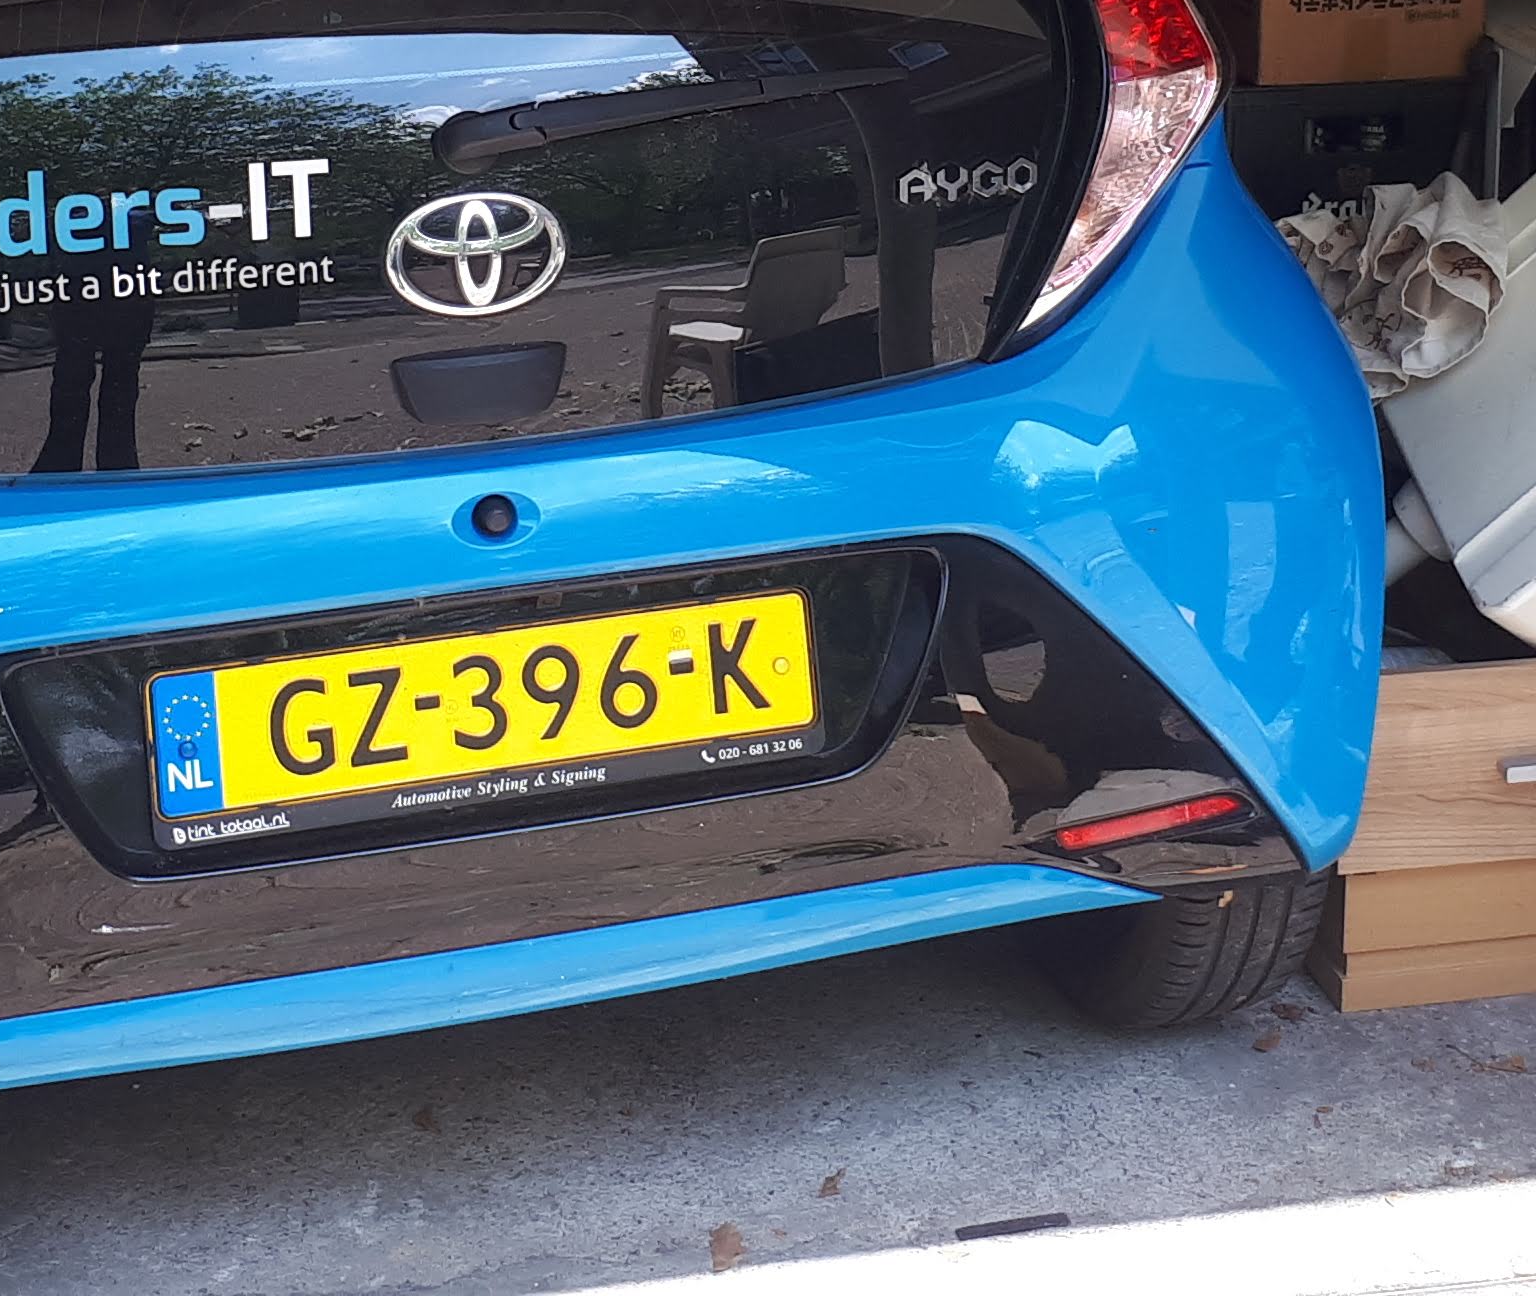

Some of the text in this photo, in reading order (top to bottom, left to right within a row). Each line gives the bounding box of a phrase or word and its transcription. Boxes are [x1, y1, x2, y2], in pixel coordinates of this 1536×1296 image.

[899, 156, 1038, 205] AYGO
[0, 255, 335, 314] just a bit different
[270, 618, 772, 776] GZ-396-K
[718, 746, 740, 760] 020
[749, 742, 769, 757] 681
[772, 740, 787, 754] 32
[787, 738, 803, 752] 06
[167, 758, 214, 793] NL
[392, 765, 607, 809] Automotive Styling & Signing
